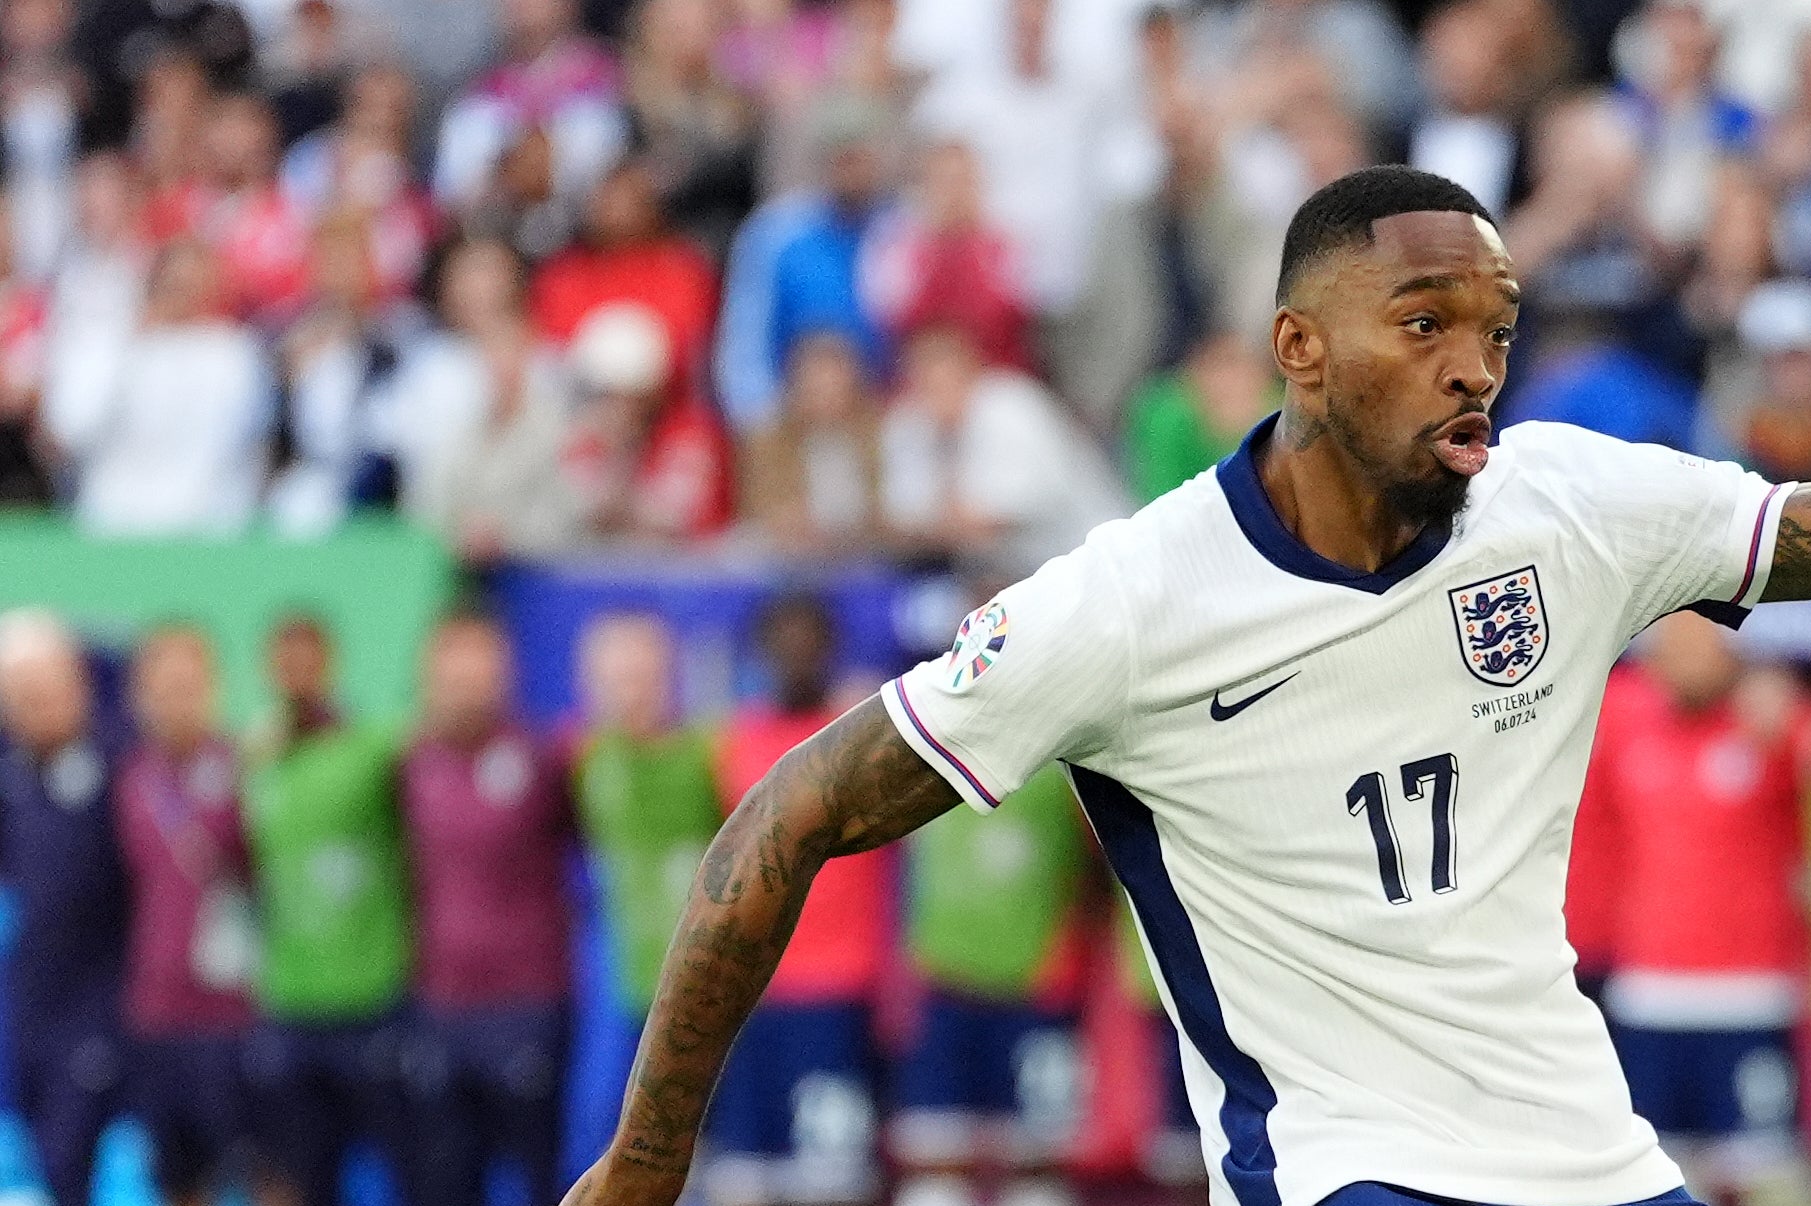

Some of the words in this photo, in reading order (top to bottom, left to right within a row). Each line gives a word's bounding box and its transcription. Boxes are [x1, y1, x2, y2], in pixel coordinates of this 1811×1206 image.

[1472, 684, 1553, 718] SWITZERLAND
[1495, 708, 1536, 733] 06.07.24
[1346, 753, 1458, 905] 17
